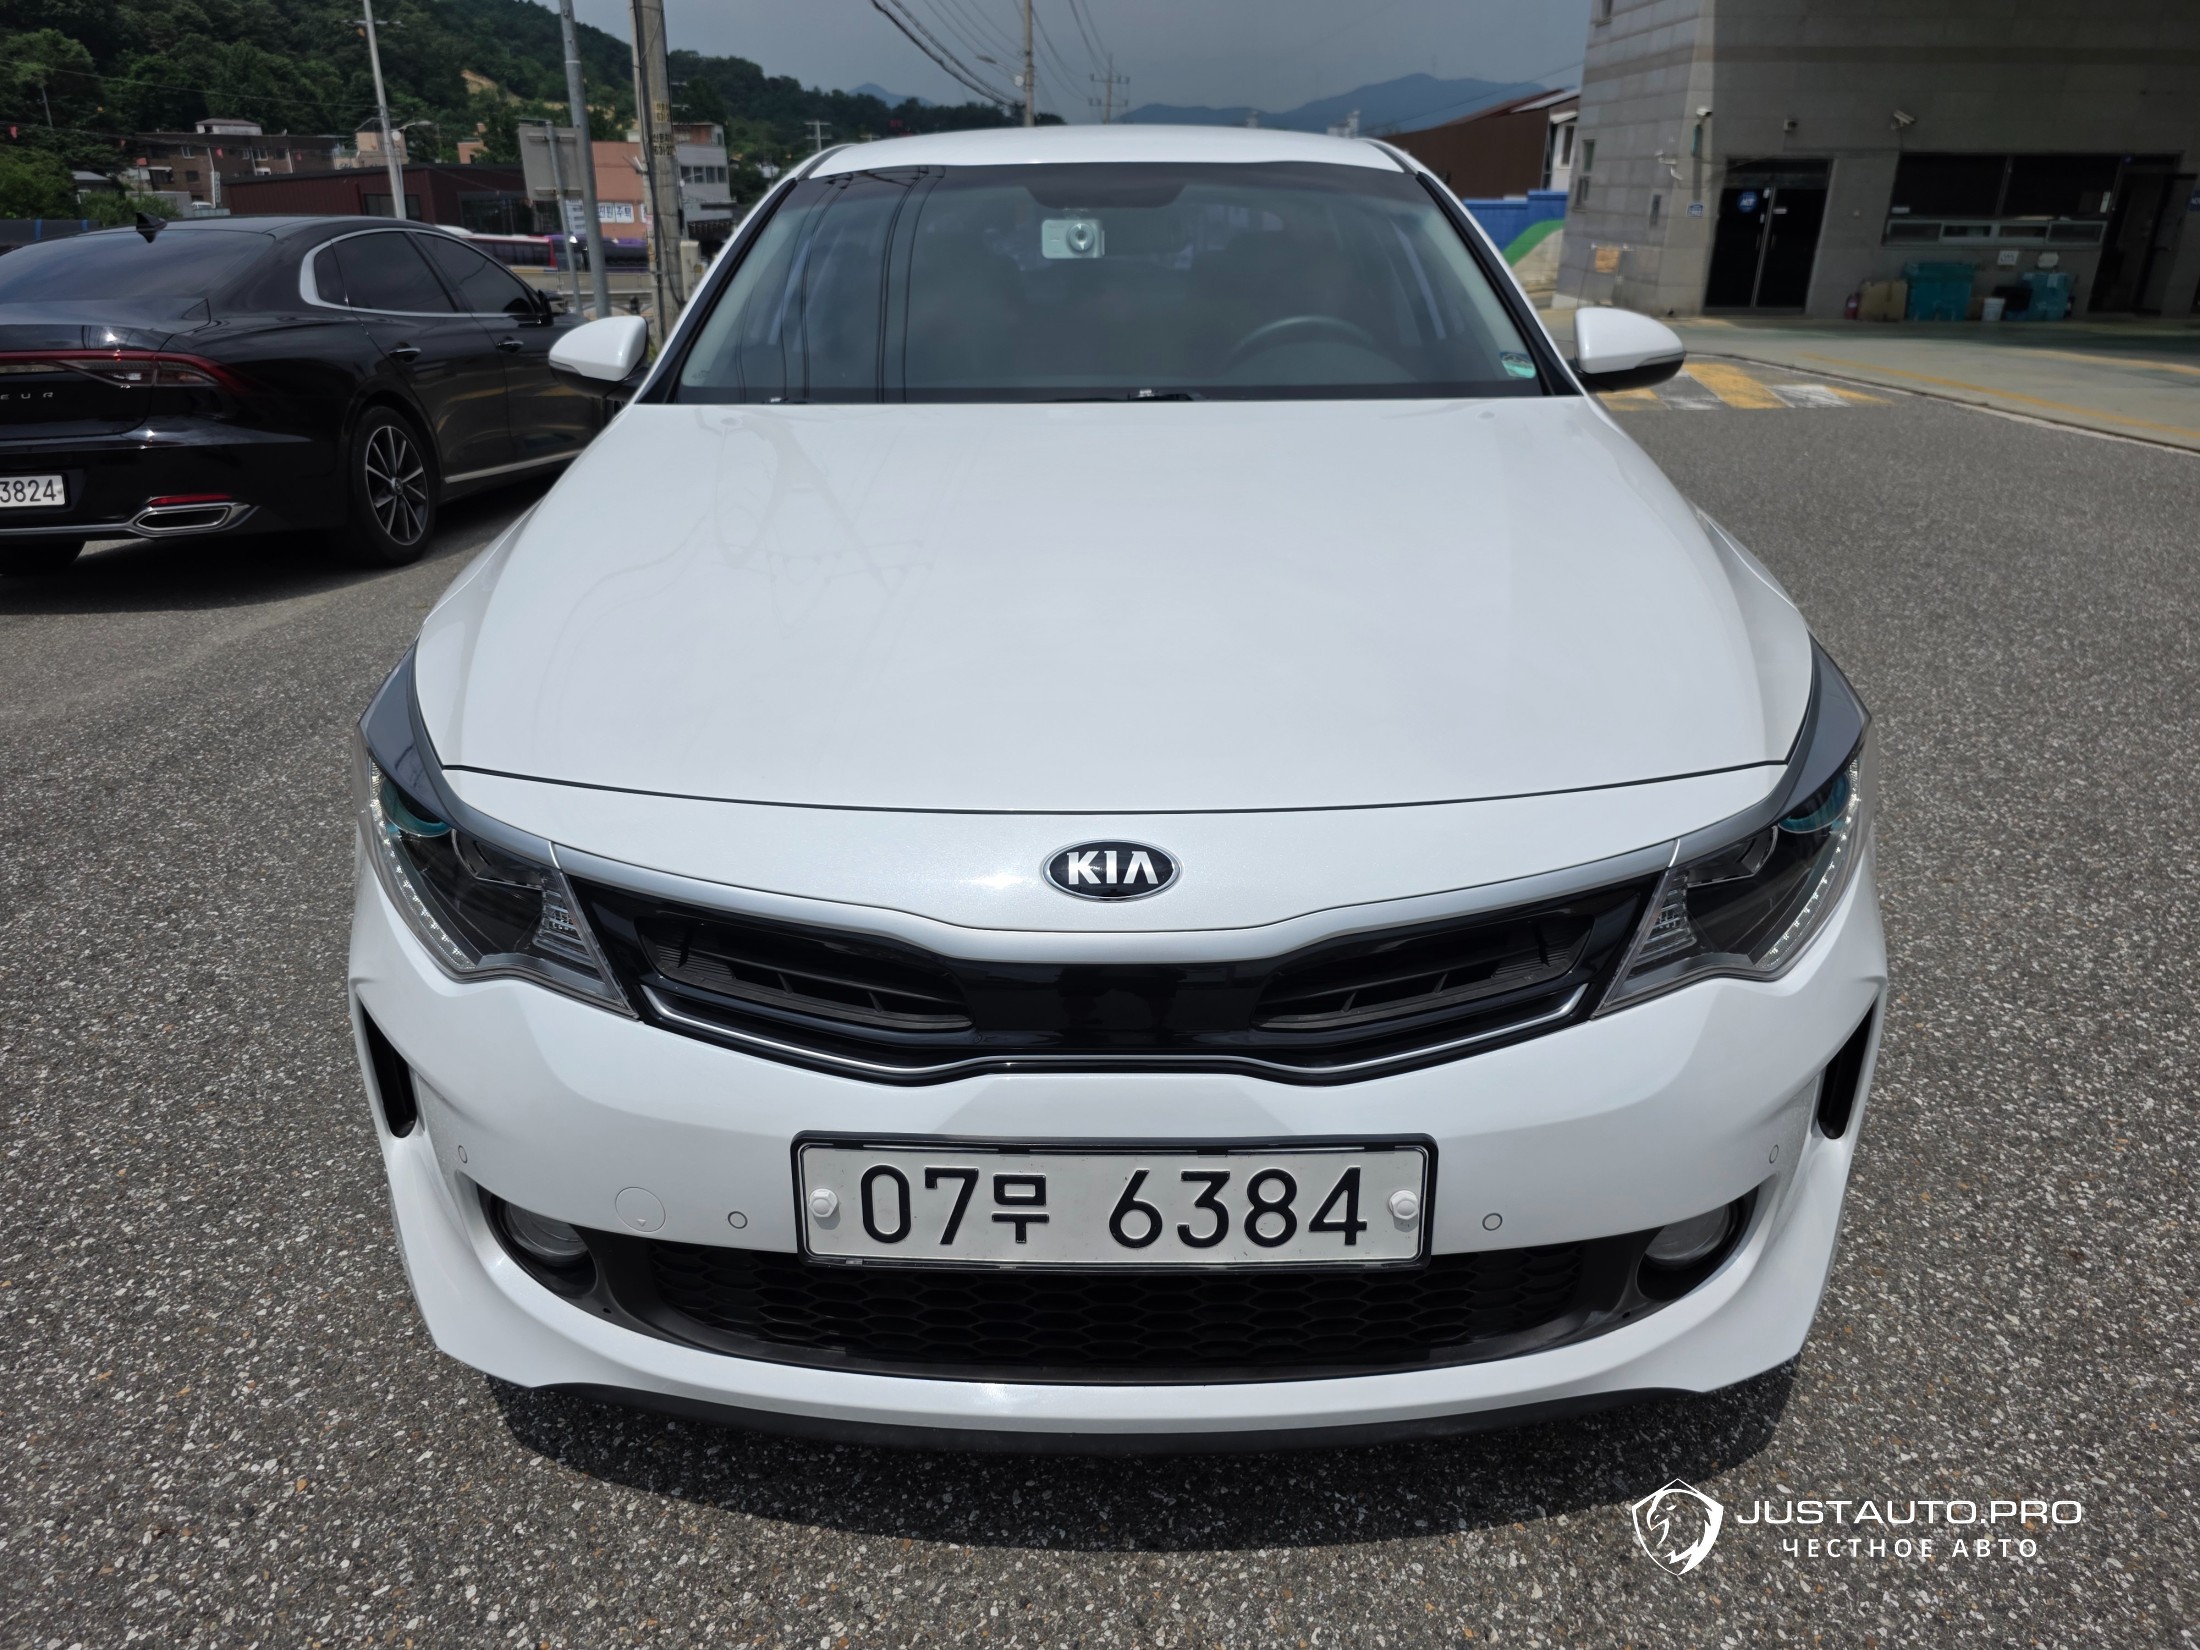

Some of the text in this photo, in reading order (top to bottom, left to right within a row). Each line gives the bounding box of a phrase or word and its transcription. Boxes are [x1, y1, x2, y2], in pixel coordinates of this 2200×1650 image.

[0, 479, 57, 503] 3824
[1066, 850, 1159, 886] KIA
[860, 1164, 1369, 1249] 07무 6384
